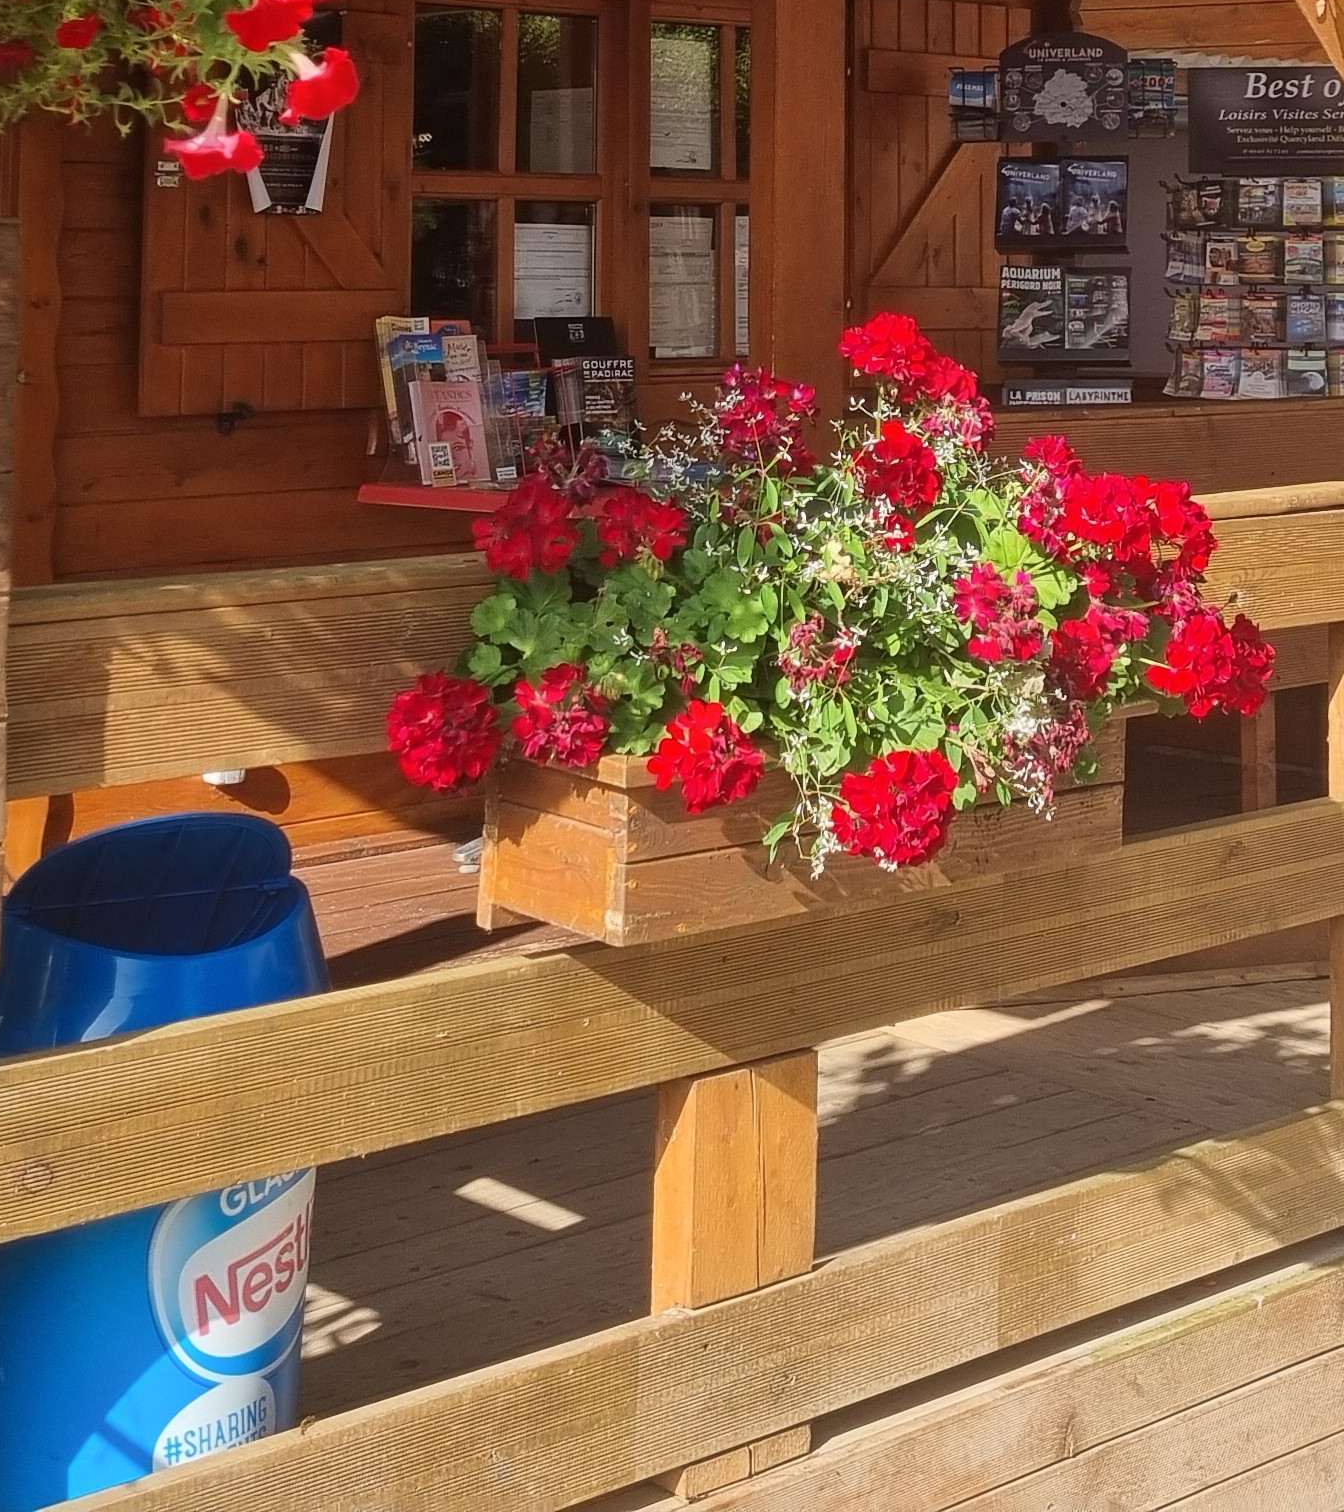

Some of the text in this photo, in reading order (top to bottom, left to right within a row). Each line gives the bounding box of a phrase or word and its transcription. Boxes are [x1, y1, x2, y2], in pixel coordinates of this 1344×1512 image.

[1027, 46, 1104, 60] UNIVERLAND
[1243, 71, 1316, 99] Best
[1218, 108, 1268, 121] Loisirs
[1272, 108, 1319, 120] Visites
[1001, 266, 1061, 280] AQUARIUM
[1042, 280, 1062, 291] NOIR
[582, 359, 634, 369] GOUFFRE
[591, 369, 634, 378] PADIRAC
[1009, 390, 1061, 402] LA PRISON
[1069, 390, 1130, 402] LABYRINTHE
[194, 1198, 312, 1337] Nestl
[163, 1395, 268, 1466] #SHARING
